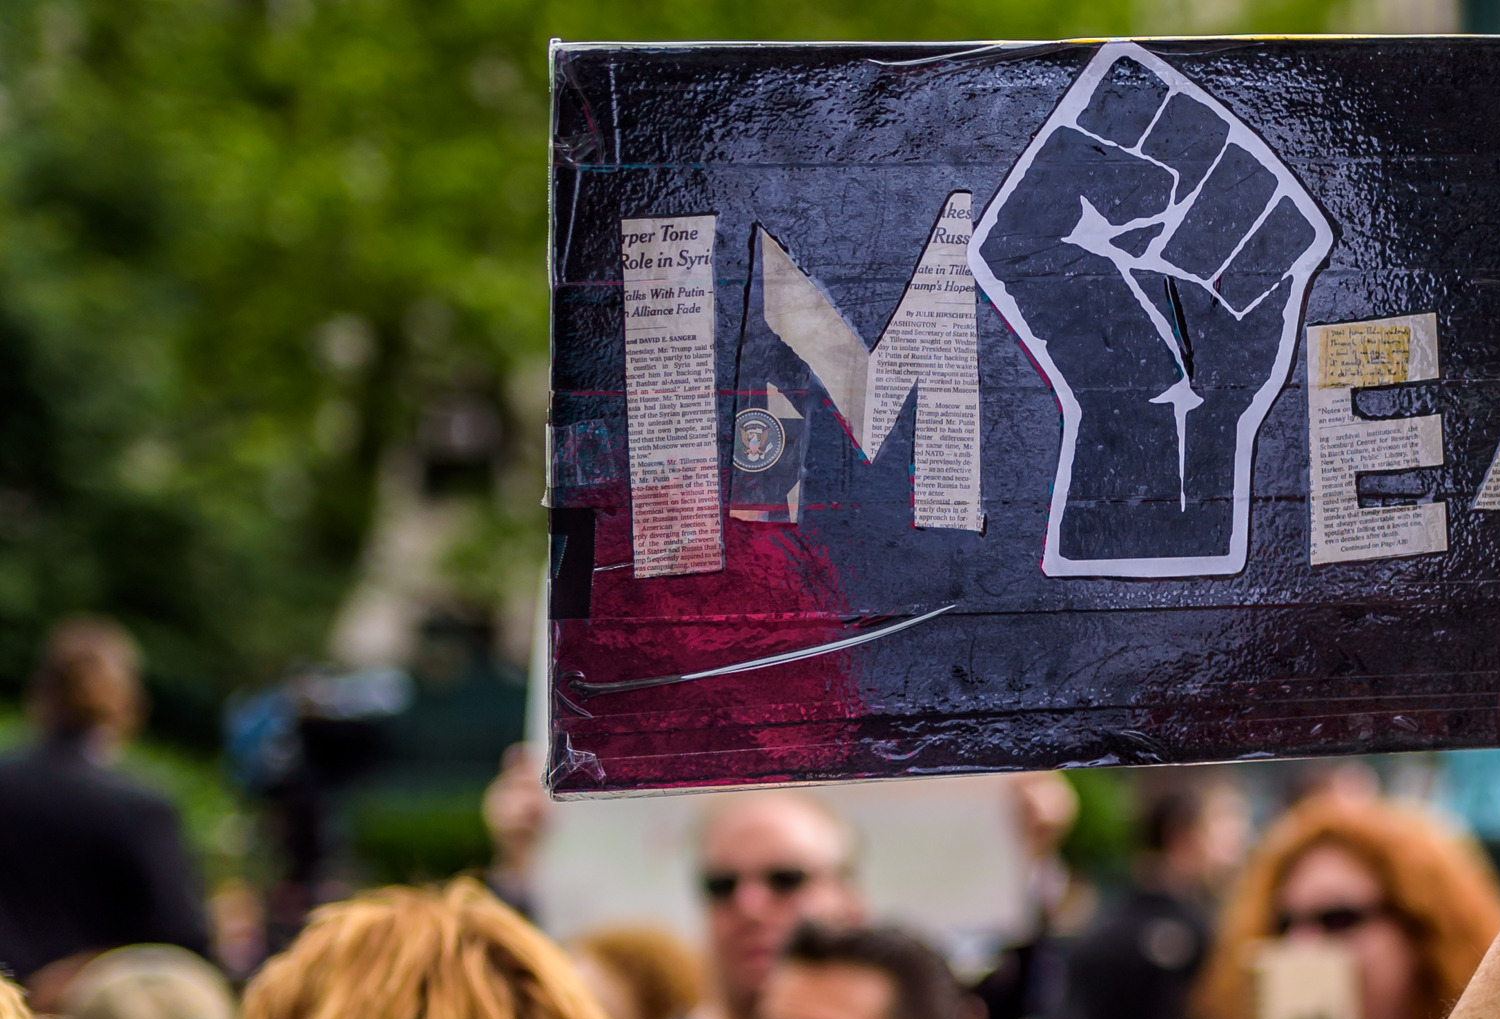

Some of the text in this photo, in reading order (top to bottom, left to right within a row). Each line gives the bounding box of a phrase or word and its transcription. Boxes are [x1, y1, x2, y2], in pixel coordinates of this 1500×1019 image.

[943, 202, 972, 219] kes
[660, 224, 699, 242] Tone
[622, 248, 713, 271] Role in Syri
[916, 264, 973, 276] ate in Tille
[944, 281, 976, 294] Hopes
[650, 287, 675, 300] With
[676, 286, 705, 299] Putin
[631, 302, 701, 318] Alliance Fade
[914, 329, 944, 338] Secretary
[639, 336, 660, 344] DAVID
[669, 334, 697, 342] SANGER
[920, 338, 941, 346] sought
[671, 345, 692, 354] Trump
[664, 354, 682, 363] partly
[944, 354, 968, 363] backing
[674, 361, 690, 370] Syria
[877, 360, 936, 370] Syrian government
[677, 368, 701, 377] backing
[675, 393, 696, 402] Trump
[660, 403, 677, 411] likely
[660, 410, 680, 419] Syrian
[919, 410, 939, 418] Trump
[675, 425, 697, 434] people,
[667, 433, 687, 441] United
[1356, 438, 1377, 446] Center
[1391, 434, 1418, 442] Research
[653, 442, 679, 450] Moscow
[945, 443, 960, 451] time,
[638, 456, 707, 469] Moscow, Tillerson
[653, 475, 670, 483] Putin
[661, 482, 684, 490] session
[635, 499, 669, 509] agreement
[636, 507, 694, 515] chemical weapons
[653, 511, 719, 522] Russian interference
[642, 523, 673, 531] American
[650, 530, 680, 540] diverging
[688, 535, 714, 543] between
[682, 544, 703, 552] Russia
